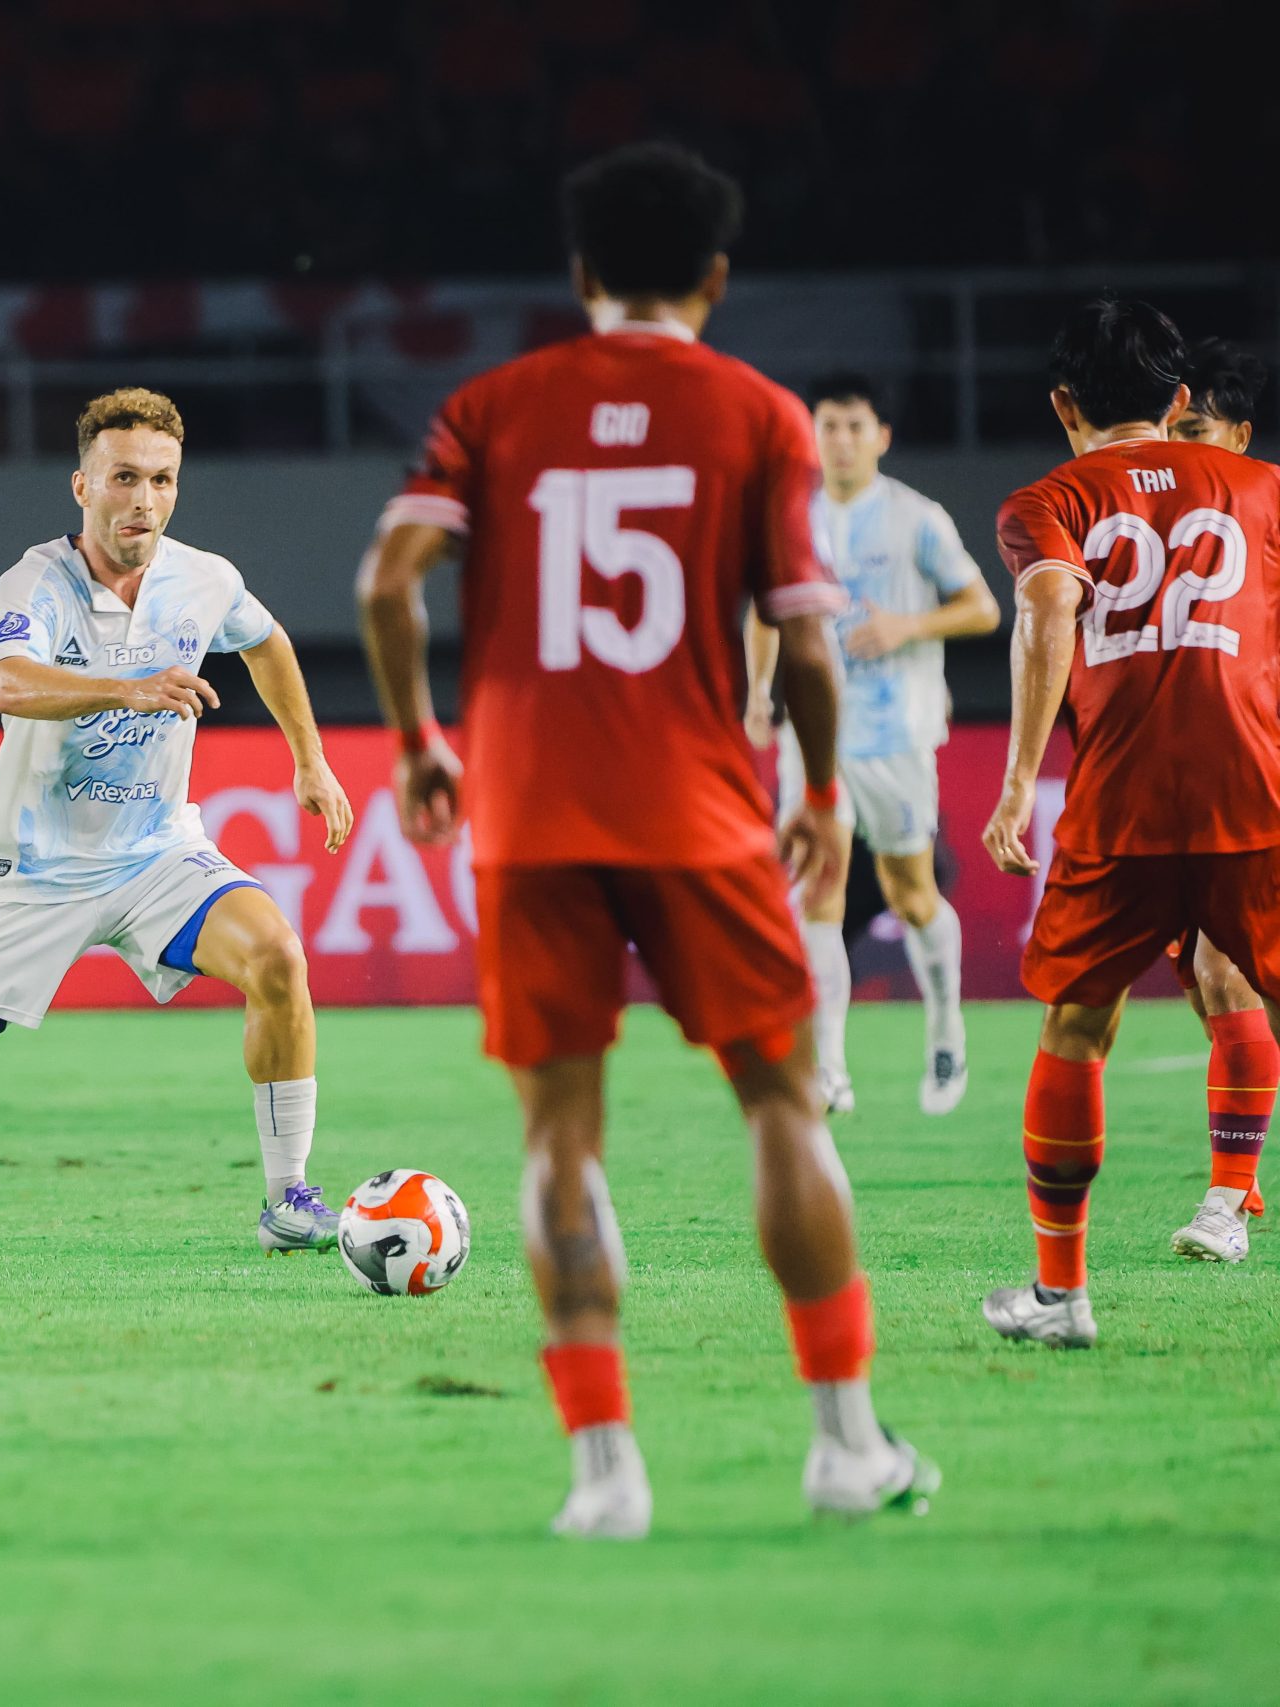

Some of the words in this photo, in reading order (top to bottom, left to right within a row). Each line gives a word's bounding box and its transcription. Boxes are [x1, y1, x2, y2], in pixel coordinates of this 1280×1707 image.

[1126, 467, 1177, 493] TAN
[529, 465, 696, 675] 15
[1083, 507, 1248, 668] 22
[55, 655, 89, 666] apex
[103, 642, 155, 667] Taro
[89, 779, 158, 804] Rexna
